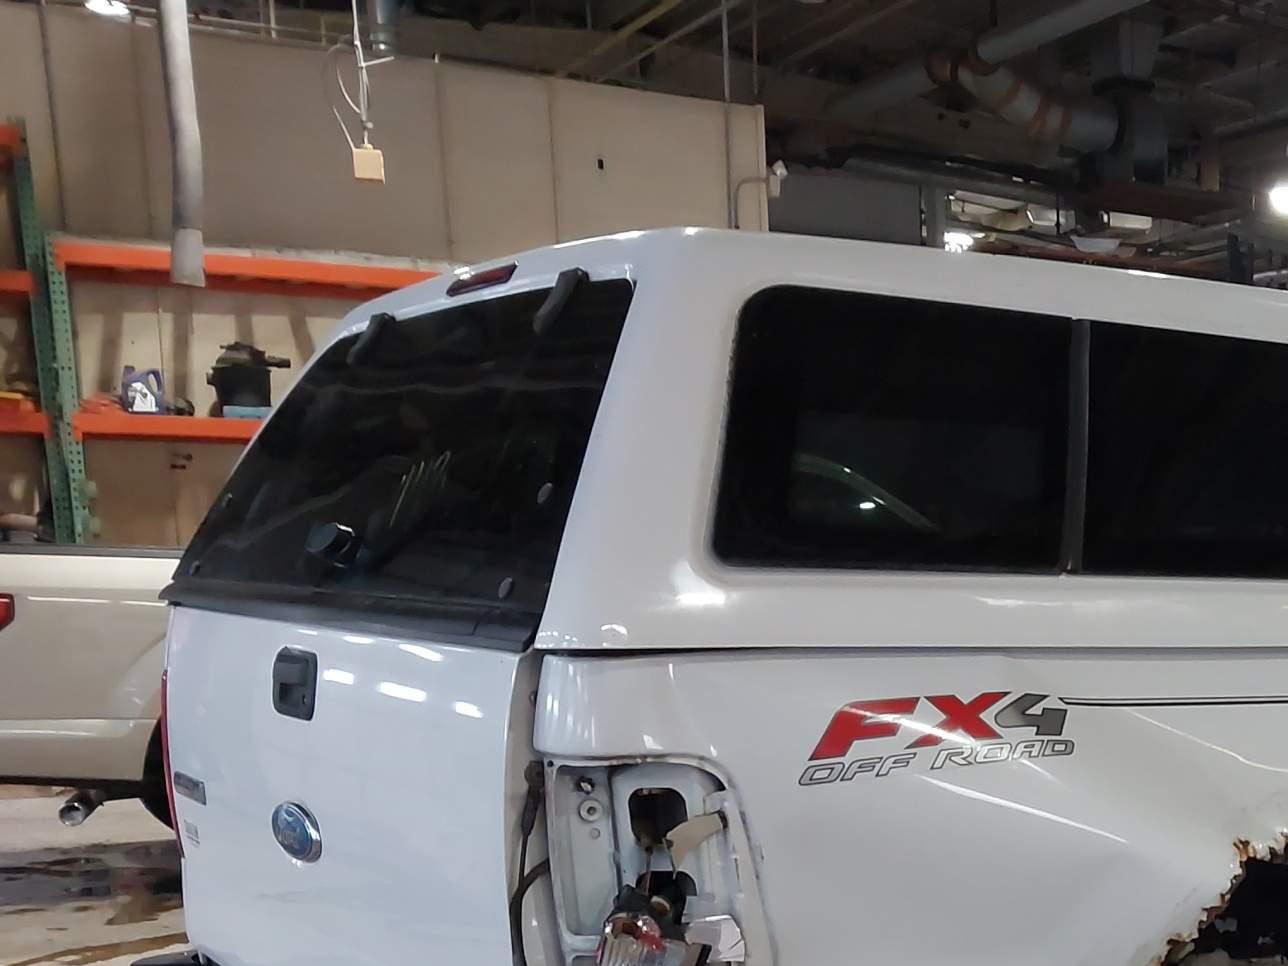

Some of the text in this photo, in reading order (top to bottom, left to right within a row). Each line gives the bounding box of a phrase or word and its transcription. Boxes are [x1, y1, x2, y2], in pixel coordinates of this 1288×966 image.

[808, 691, 1068, 762] FX4
[798, 739, 1075, 786] OFF ROAD
